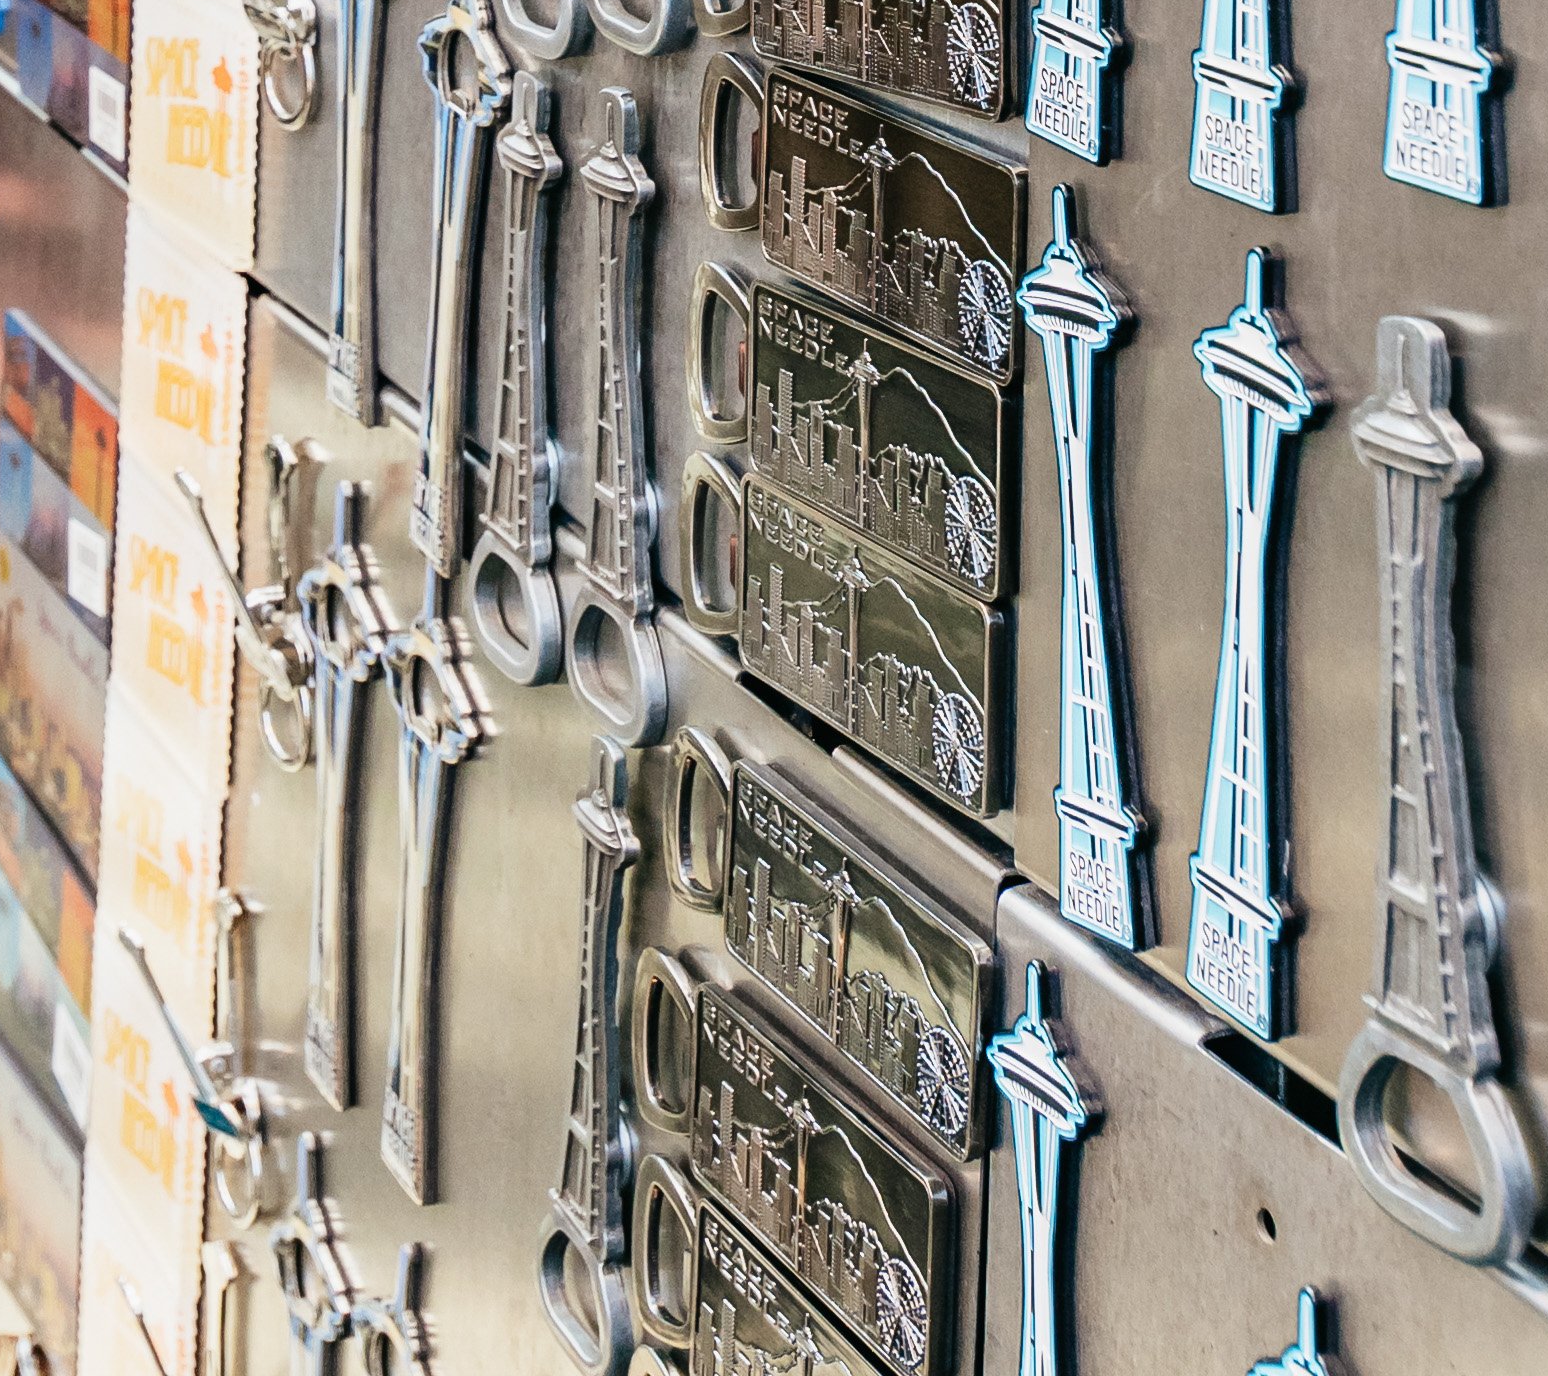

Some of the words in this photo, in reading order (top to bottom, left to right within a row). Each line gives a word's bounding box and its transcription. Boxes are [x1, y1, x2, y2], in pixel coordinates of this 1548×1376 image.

[772, 84, 849, 131] SPACE
[1040, 67, 1085, 110] SPACE
[772, 104, 864, 160] NEEDLE
[1205, 114, 1254, 156] SPACE
[1402, 101, 1459, 144] SPACE
[757, 315, 850, 376] NEEDLE
[758, 293, 834, 344] SPACE
[747, 508, 840, 573] NEEDLE
[749, 486, 824, 546] SPACE
[737, 799, 829, 889] NEEDLE
[738, 783, 813, 852] SPACE
[1069, 851, 1114, 895] SPACE
[1202, 922, 1252, 979] SPACE
[703, 1022, 791, 1108] NEEDLE
[704, 1005, 775, 1079] SPACE
[705, 1216, 777, 1301] SPACE
[704, 1237, 795, 1345] NEEDLE
